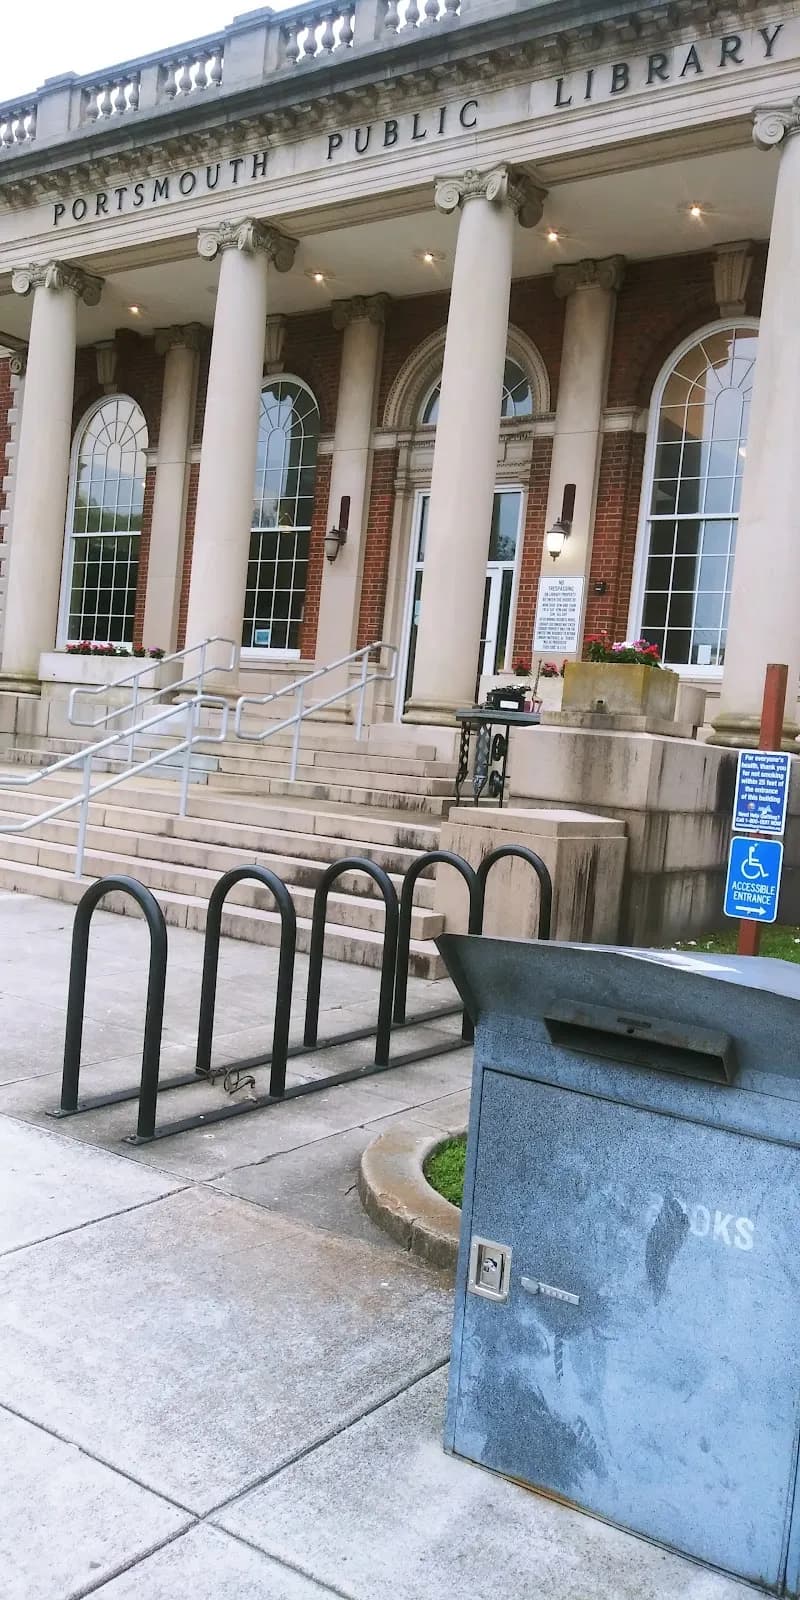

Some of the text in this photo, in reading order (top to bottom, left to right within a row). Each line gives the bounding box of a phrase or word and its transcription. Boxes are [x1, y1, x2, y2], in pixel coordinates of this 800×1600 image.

[52, 24, 784, 226] PORTSMOUTH PUBLIC LIBRARY
[761, 772, 784, 780] smoking
[758, 795, 781, 804] building
[732, 881, 776, 896] ACCESSIBLE
[733, 891, 771, 905] ENTRANCE
